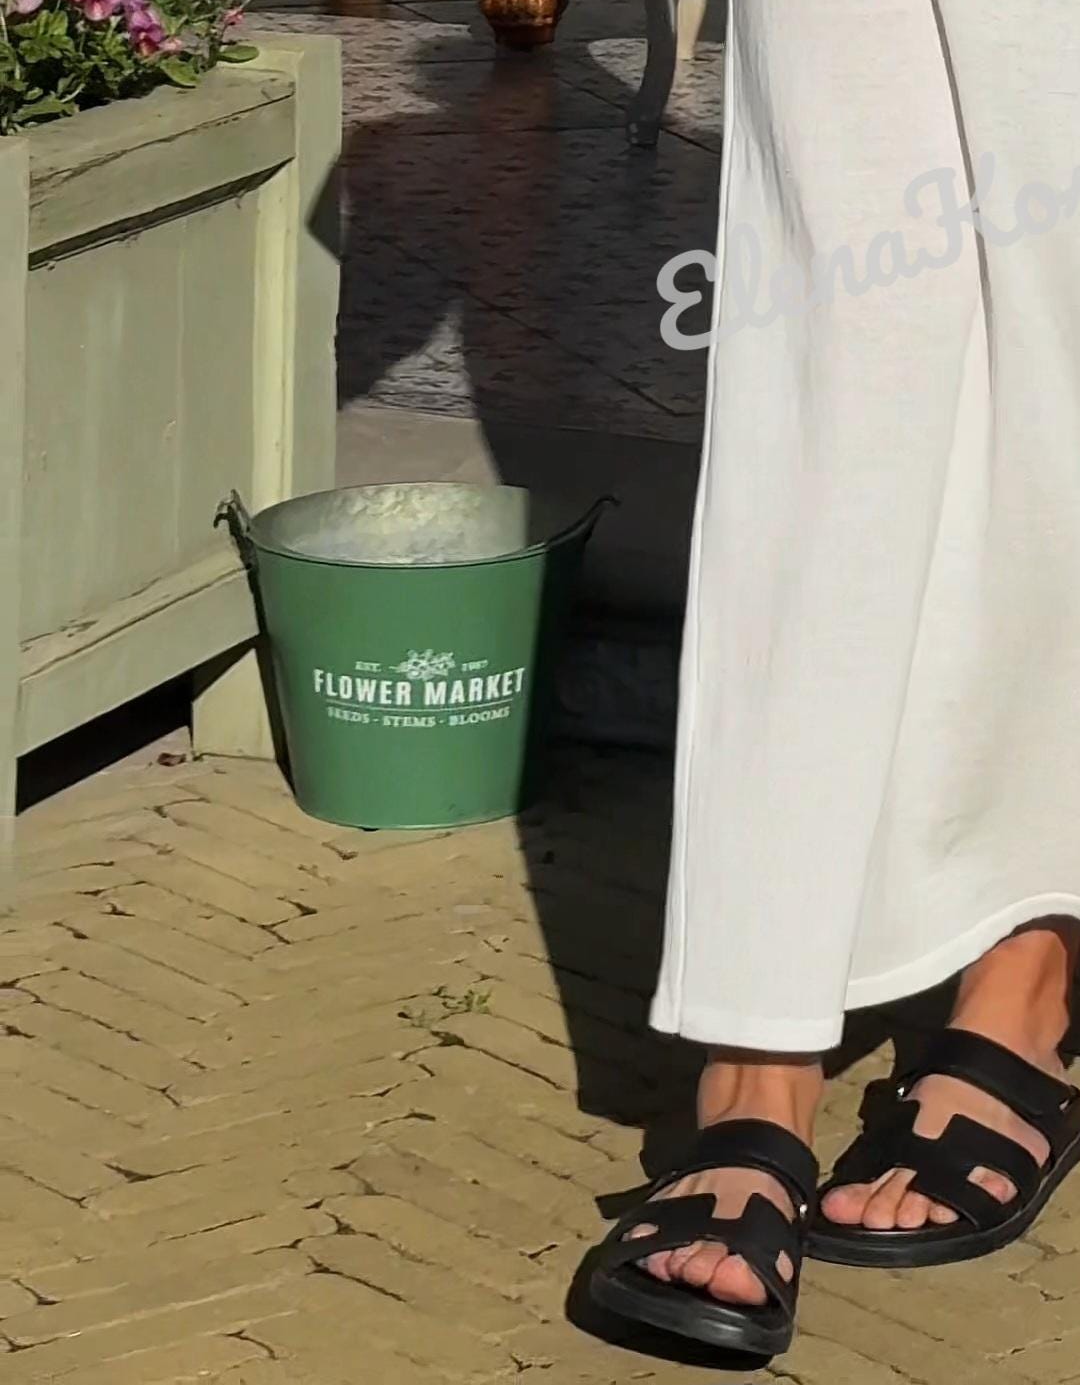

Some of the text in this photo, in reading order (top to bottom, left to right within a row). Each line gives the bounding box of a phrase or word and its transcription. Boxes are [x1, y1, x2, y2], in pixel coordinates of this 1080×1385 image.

[313, 667, 525, 706] FLOWER MARKET
[383, 715, 437, 728] STEMS
[448, 706, 510, 726] BLOOMS
